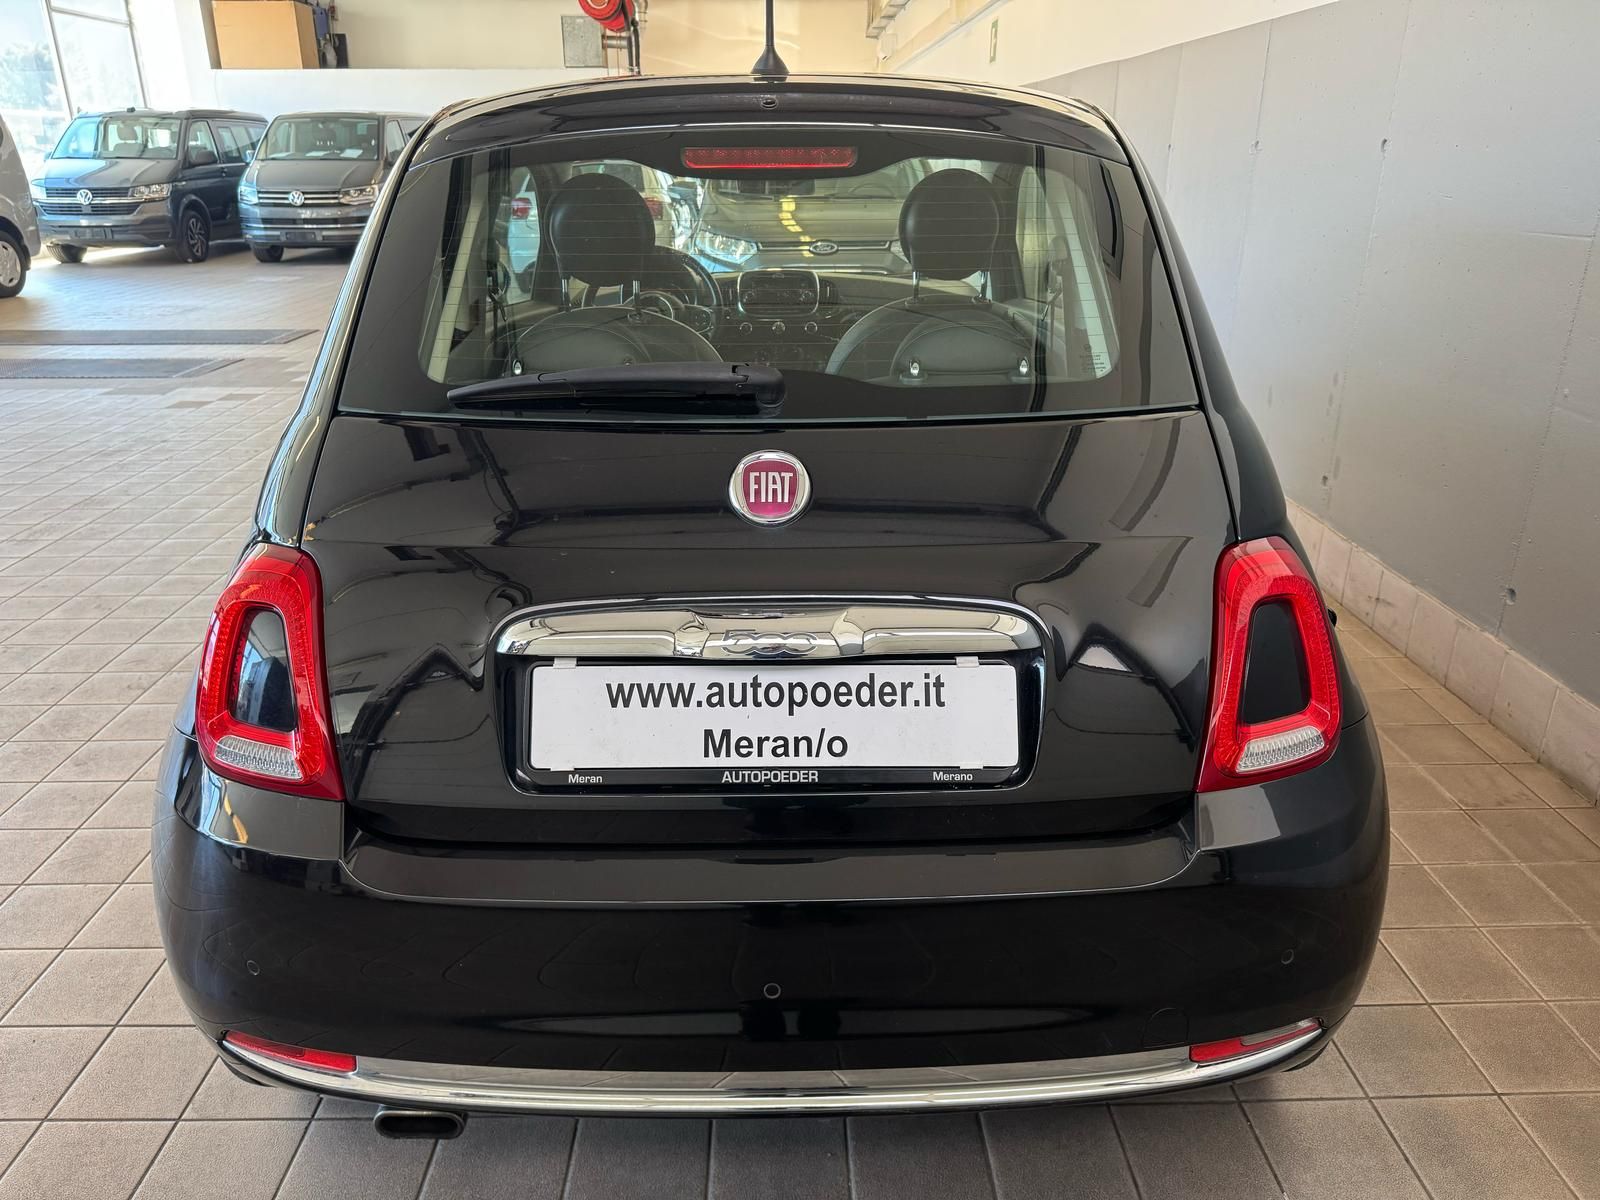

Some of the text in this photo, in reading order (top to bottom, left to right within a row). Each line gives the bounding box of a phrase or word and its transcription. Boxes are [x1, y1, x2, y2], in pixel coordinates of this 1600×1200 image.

[749, 471, 794, 503] FIAT
[606, 673, 946, 716] www.autopoeder.it
[703, 728, 849, 759] Meran/o
[567, 773, 603, 784] Meran
[721, 770, 819, 784] AUTOPOEDER
[932, 771, 974, 782] Merano
